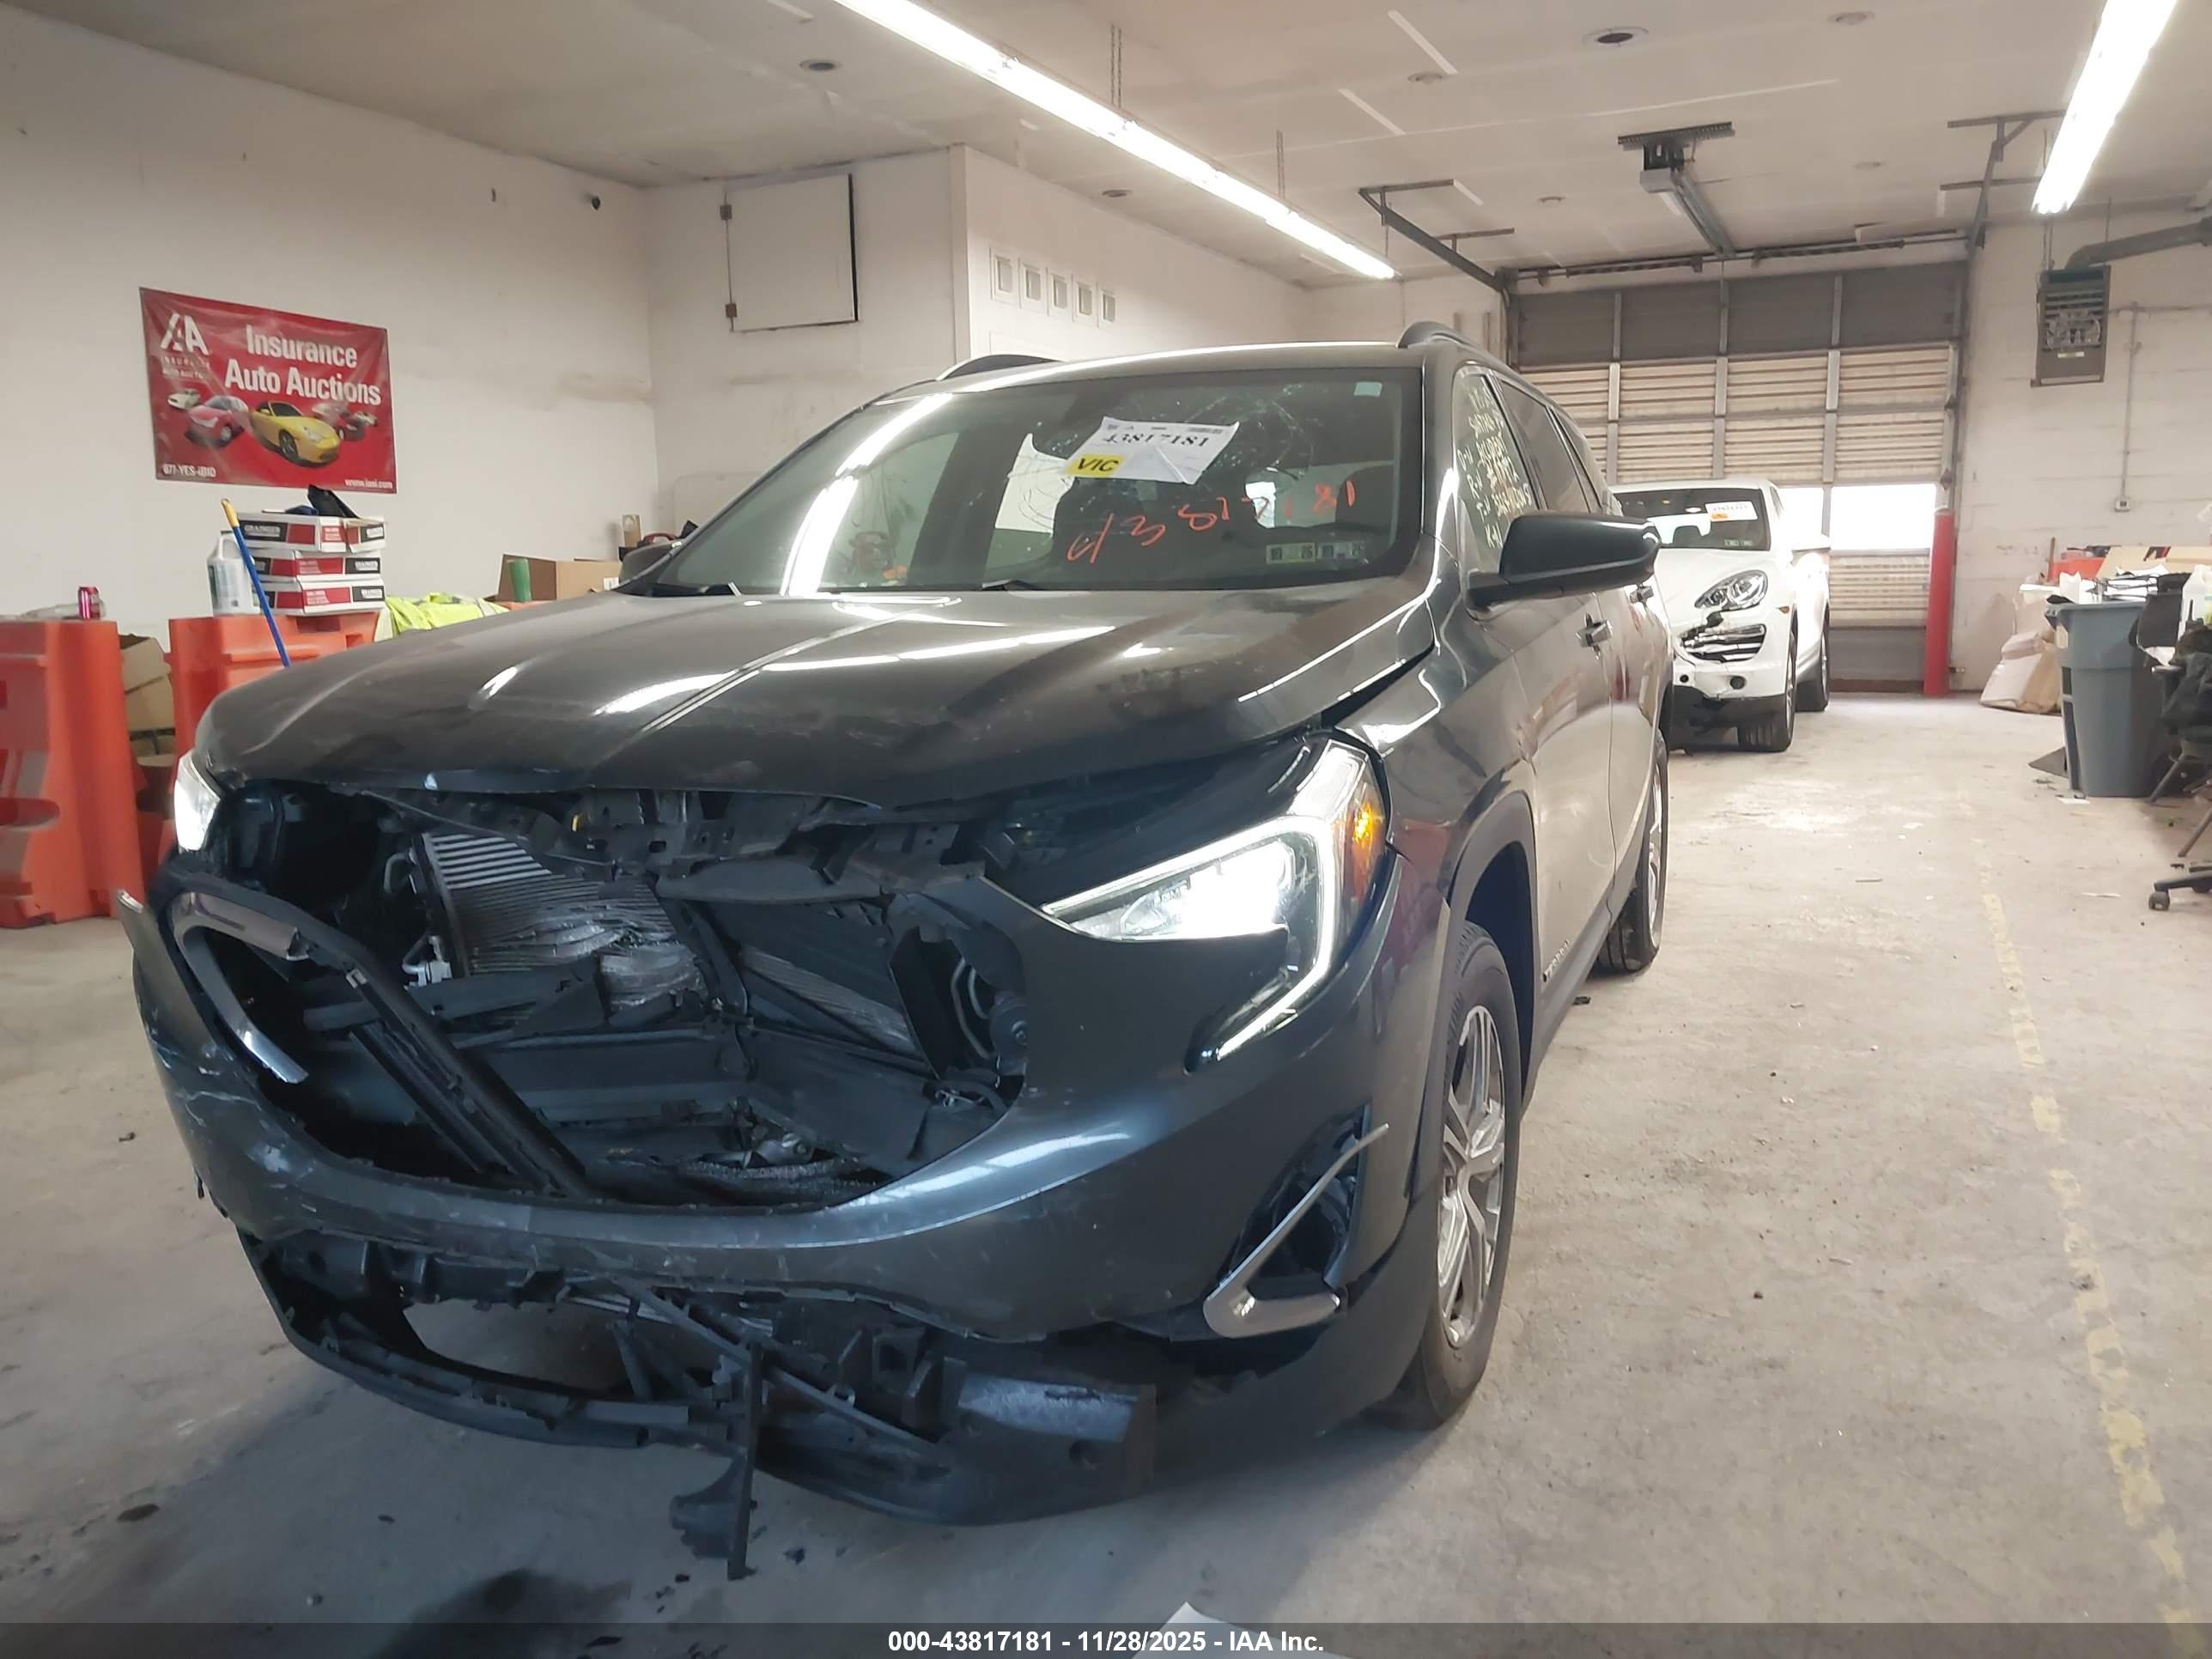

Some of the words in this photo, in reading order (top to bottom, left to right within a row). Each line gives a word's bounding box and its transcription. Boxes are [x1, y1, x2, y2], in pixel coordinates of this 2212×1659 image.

[246, 324, 358, 368] Insurance
[224, 358, 281, 394] Auto
[286, 367, 382, 406] Auctions
[1078, 458, 1120, 472] VIC
